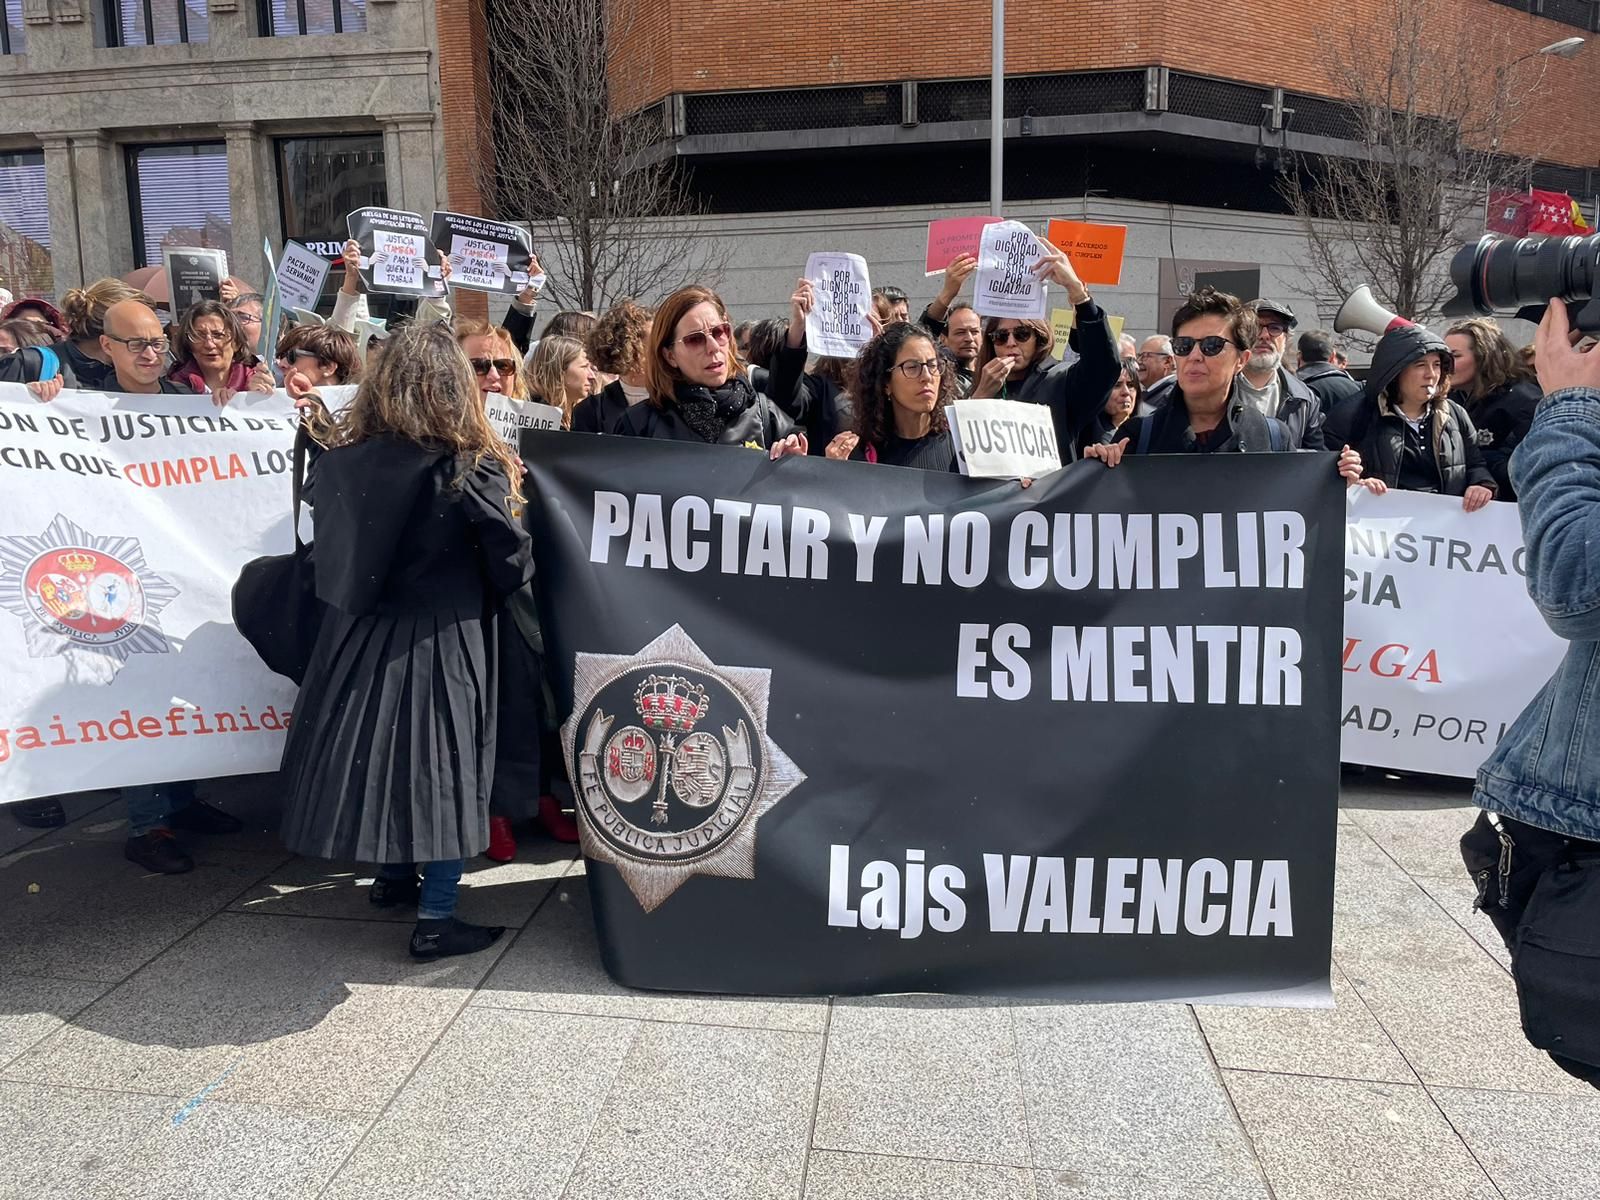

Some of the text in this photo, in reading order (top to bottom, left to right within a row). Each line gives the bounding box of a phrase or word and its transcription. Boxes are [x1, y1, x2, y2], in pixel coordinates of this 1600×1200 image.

[445, 216, 464, 224] HUELGA
[483, 223, 506, 233] LETRADOS
[386, 235, 414, 245] JUSTICIA
[464, 240, 496, 251] JUSTICIA
[1011, 232, 1028, 245] POR
[1076, 242, 1108, 250] ACUERDOS
[995, 239, 1040, 257] DIGNIDAD,
[1075, 251, 1103, 259] CUMPLEN
[287, 256, 320, 277] PACTA SUNT
[393, 255, 409, 264] PARA
[470, 258, 488, 268] PARA
[1007, 253, 1025, 266] POR
[286, 265, 315, 285] SERVANDA
[385, 264, 415, 275] QUIEN LA
[462, 266, 495, 278] QUIEN LA
[994, 259, 1036, 276] JUSTICIA,
[387, 274, 413, 283] TRABAJA
[463, 274, 492, 284] TRABAJA
[834, 270, 851, 283] POR
[1005, 271, 1022, 286] POR
[989, 279, 1031, 295] IGUALDAD
[833, 291, 849, 303] POR
[833, 312, 849, 325] POR
[821, 321, 861, 336] IGUALDAD
[489, 408, 554, 430] PILAR, DEJA DE
[46, 416, 89, 441] DE
[100, 413, 238, 443] JUSTICIA
[243, 417, 283, 431] DE
[503, 427, 517, 440] VIA
[965, 419, 1058, 460] JUSTICIA!
[0, 447, 56, 470] CIA
[60, 452, 122, 479] QUE
[124, 453, 248, 488] CUMPLA
[590, 490, 1306, 590] PACTAR Y NO CUMPLIR
[957, 622, 1302, 705] ES MENTIR
[1343, 637, 1442, 684] LGA
[1413, 713, 1487, 745] POR
[582, 772, 751, 853] FE PUBLICA JUDICIAL
[828, 844, 1294, 940] Lajs VALENCIA
